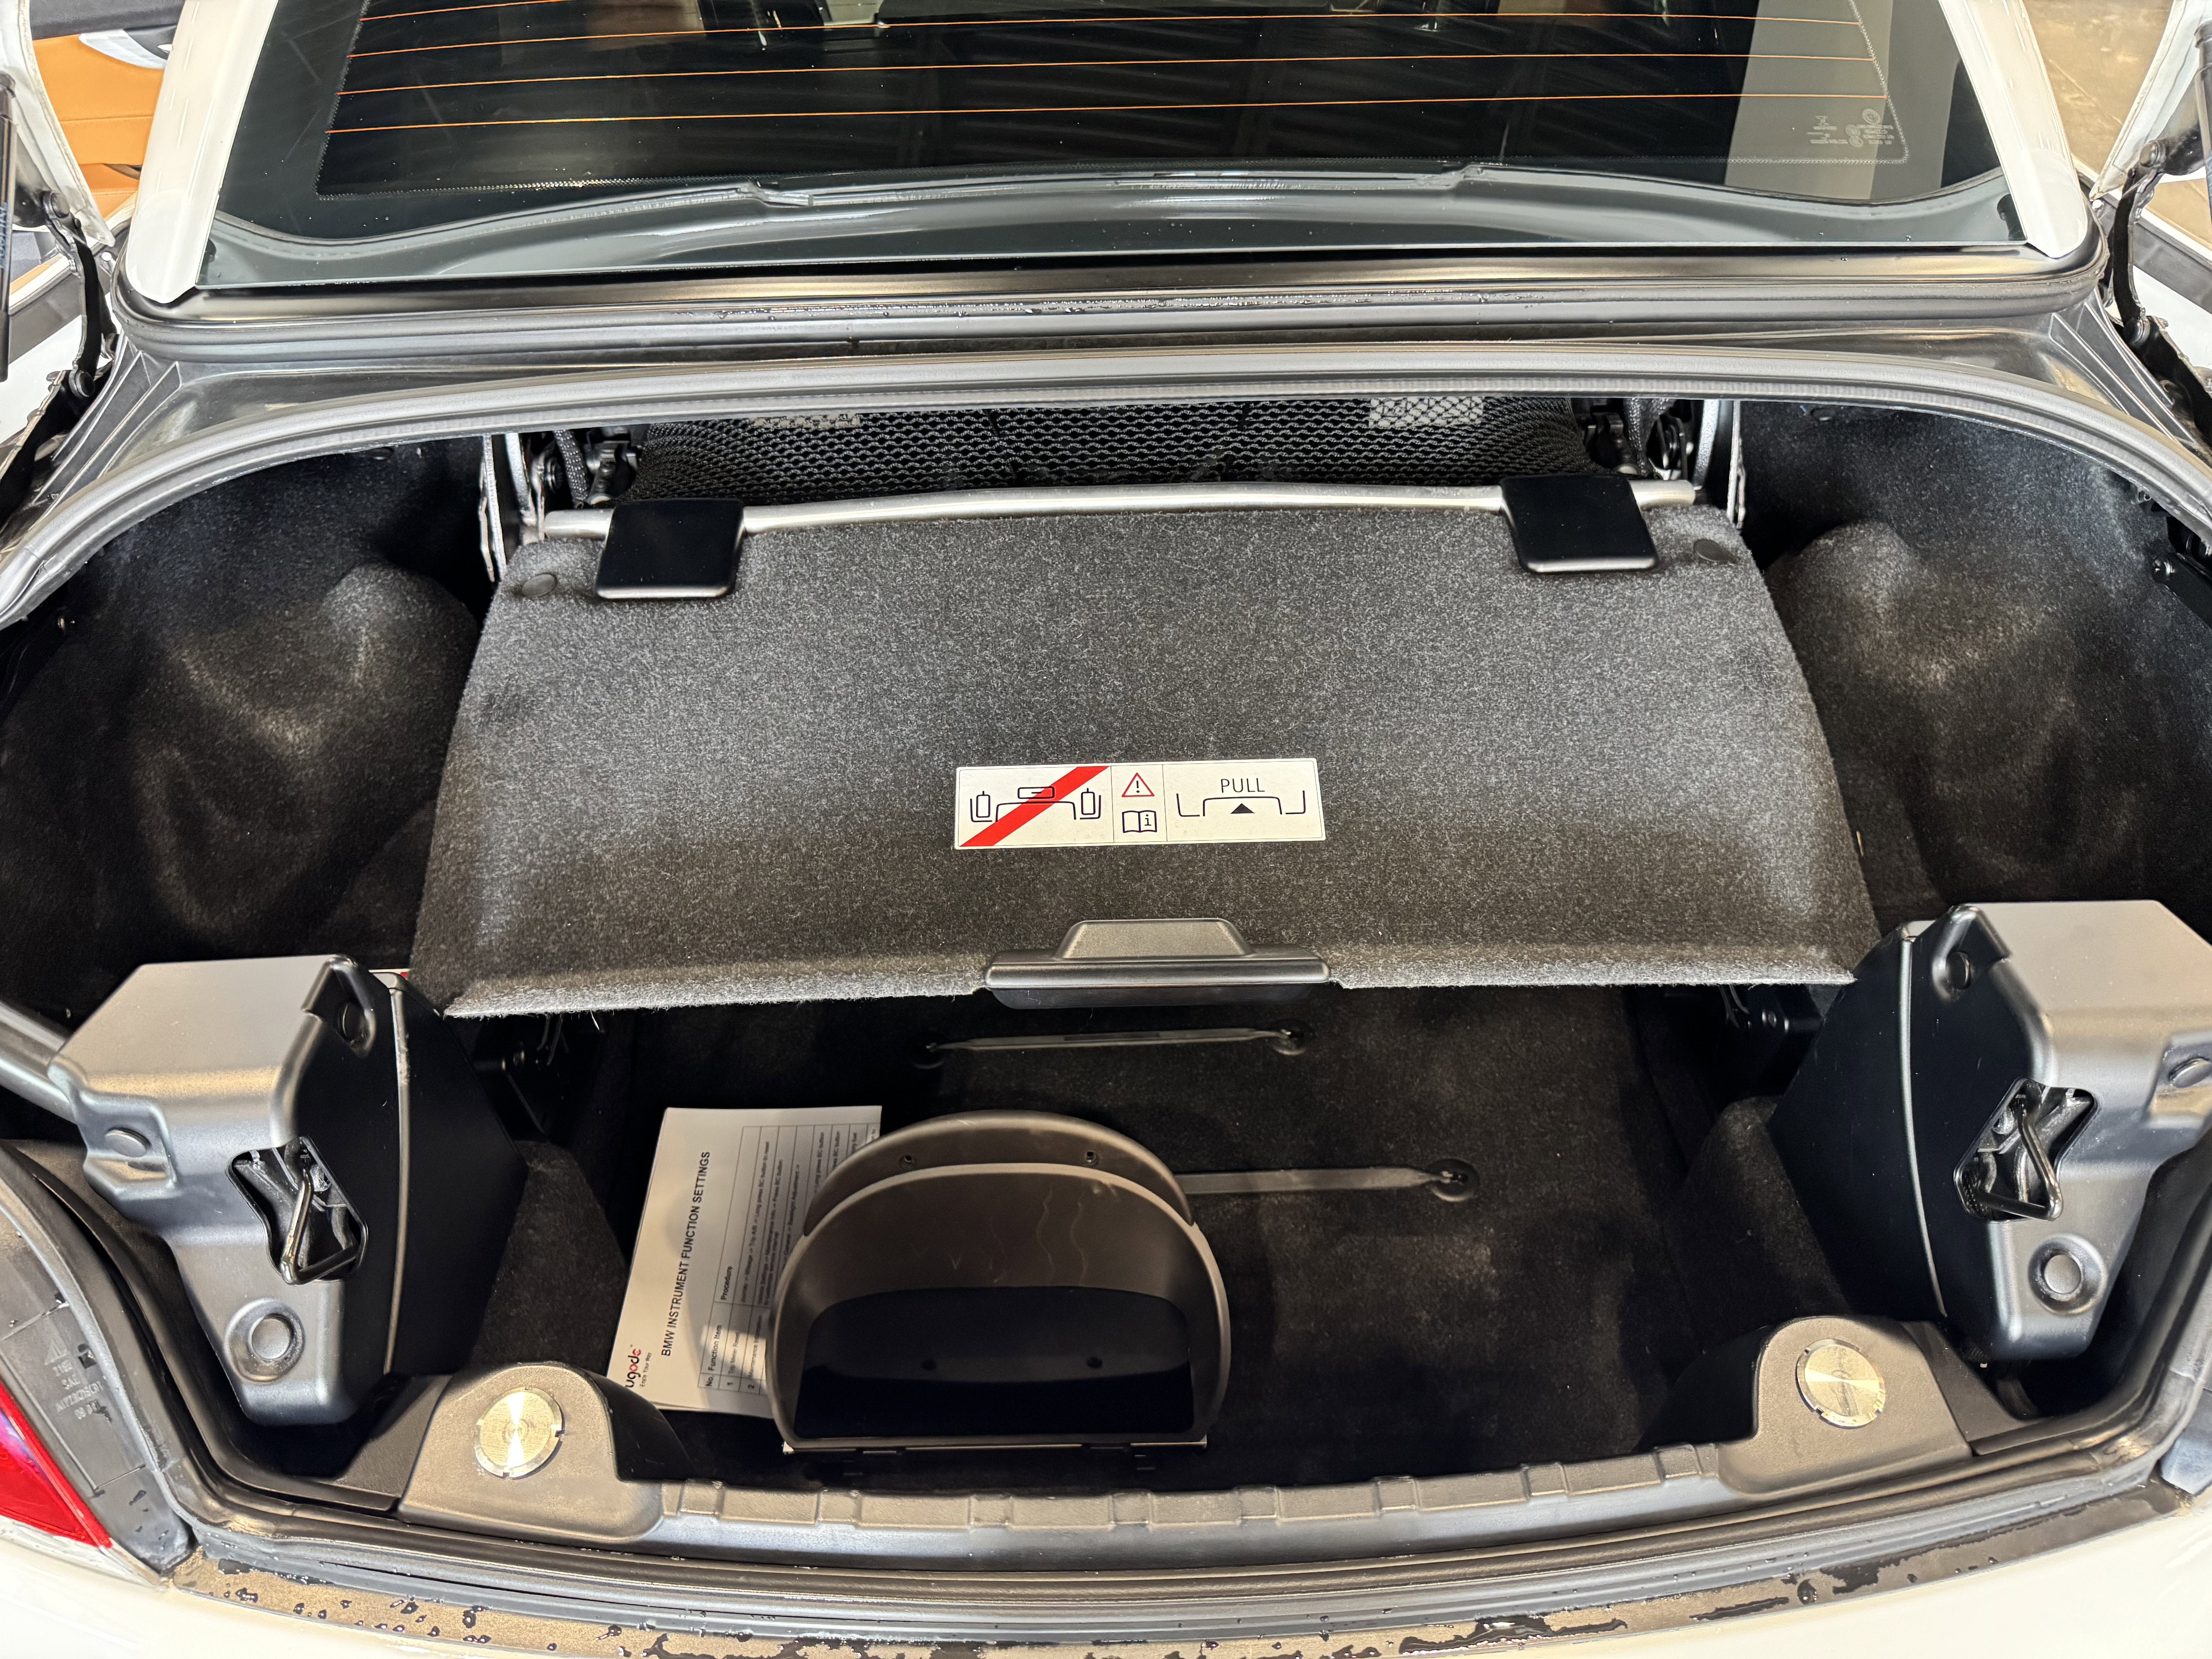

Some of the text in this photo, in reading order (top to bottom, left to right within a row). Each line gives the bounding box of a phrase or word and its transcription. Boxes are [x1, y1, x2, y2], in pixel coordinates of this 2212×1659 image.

[1221, 778, 1265, 793] PULL
[661, 1151, 710, 1357] BMW INSTRUMENT FUNCTION SETTINGS
[720, 1265, 732, 1301] Procedure
[708, 1341, 719, 1371] Function
